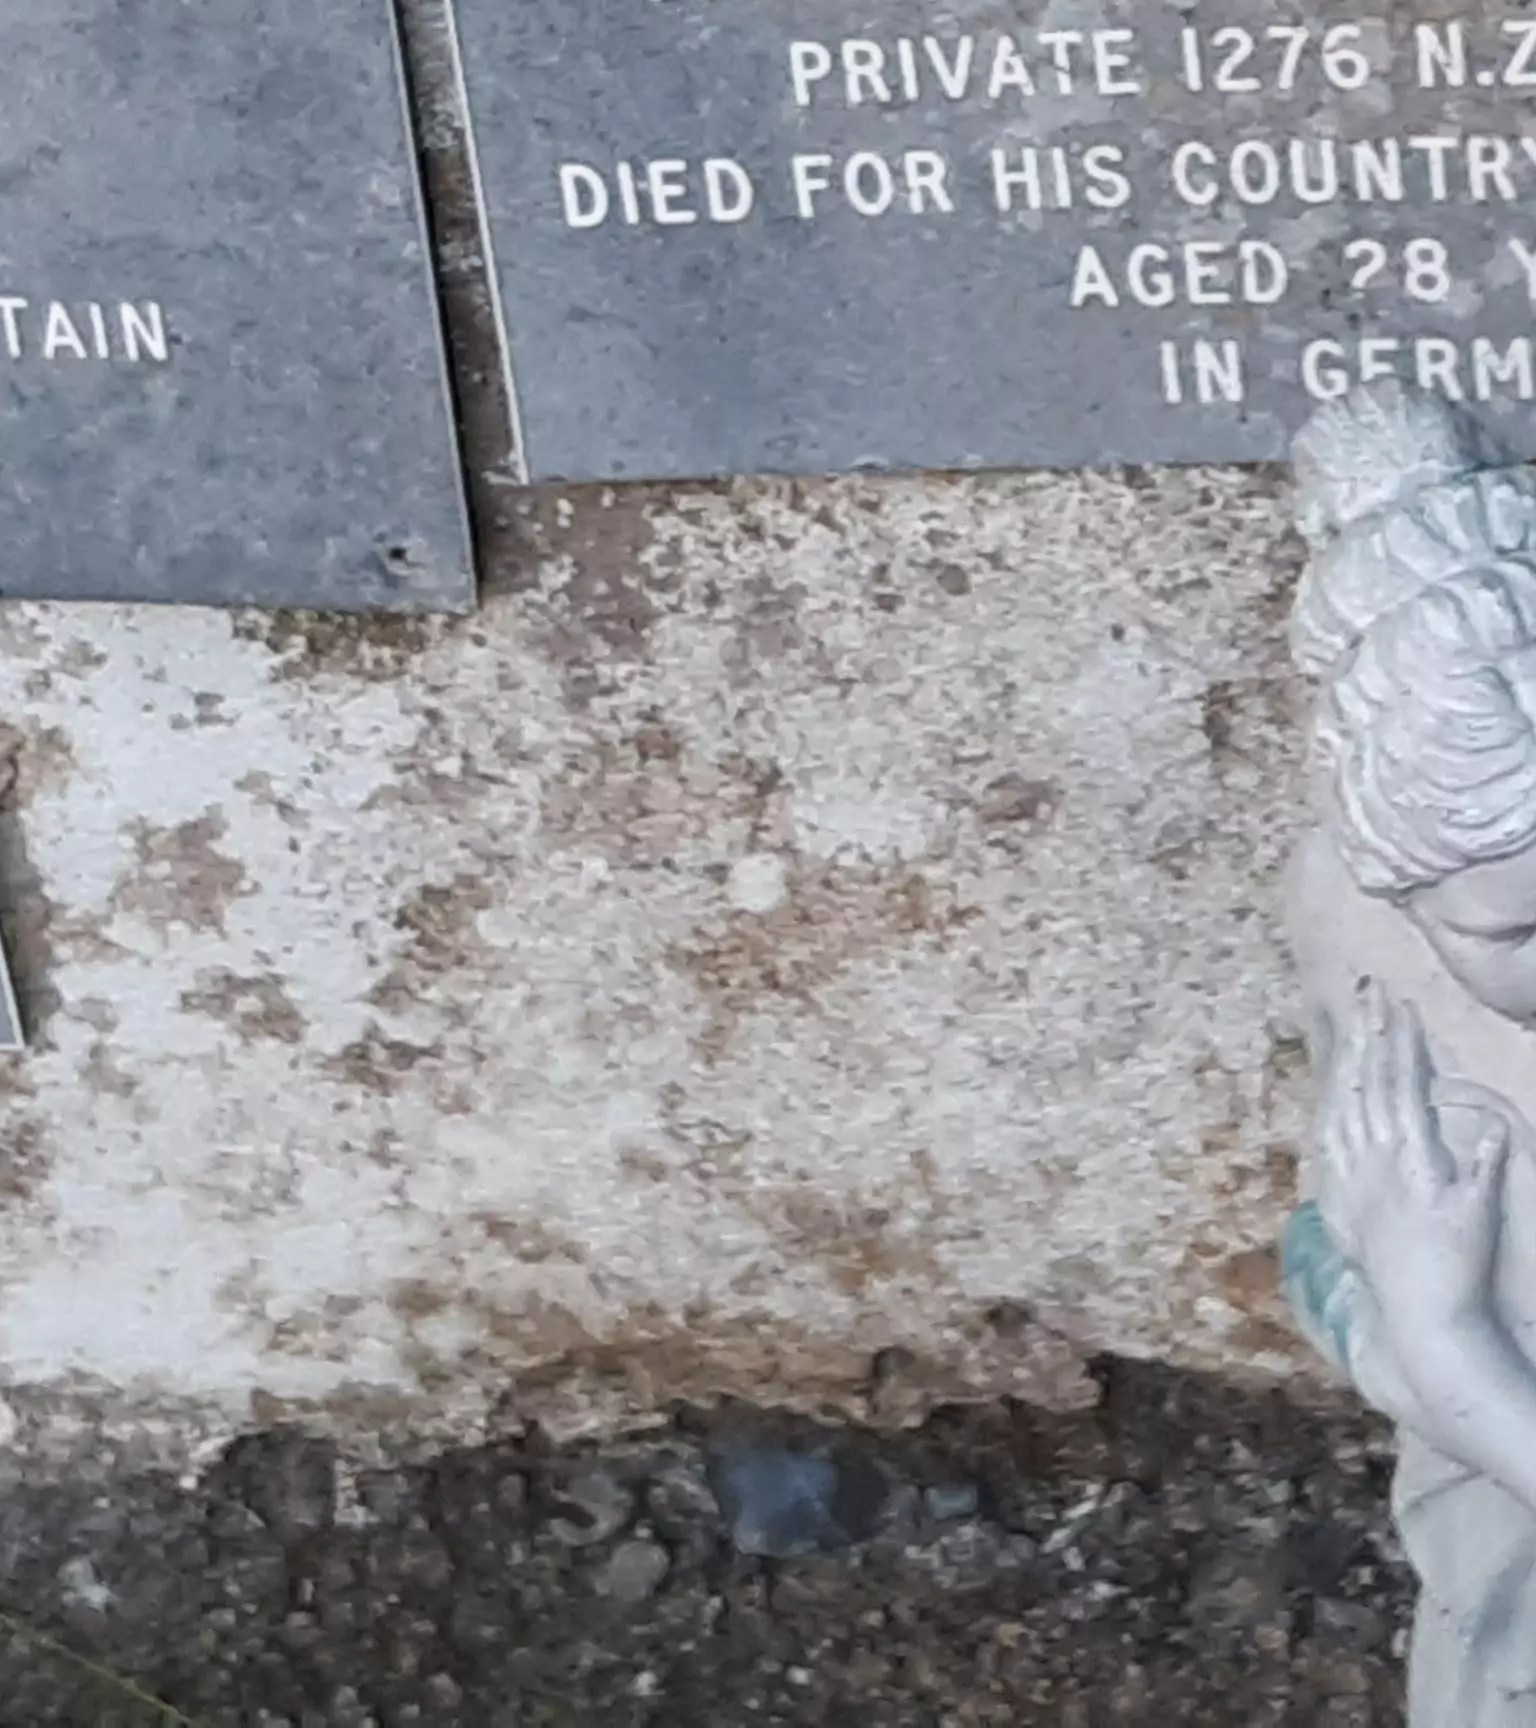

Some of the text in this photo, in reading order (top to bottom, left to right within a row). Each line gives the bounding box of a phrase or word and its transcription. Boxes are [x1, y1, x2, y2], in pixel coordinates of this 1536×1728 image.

[788, 28, 1142, 106] PRIVATE
[1181, 23, 1370, 92] 1276
[558, 157, 753, 228] DIED
[791, 149, 954, 219] FOR
[990, 144, 1131, 212] HIS
[1071, 239, 1288, 307] AGED
[1160, 339, 1243, 405] IN
